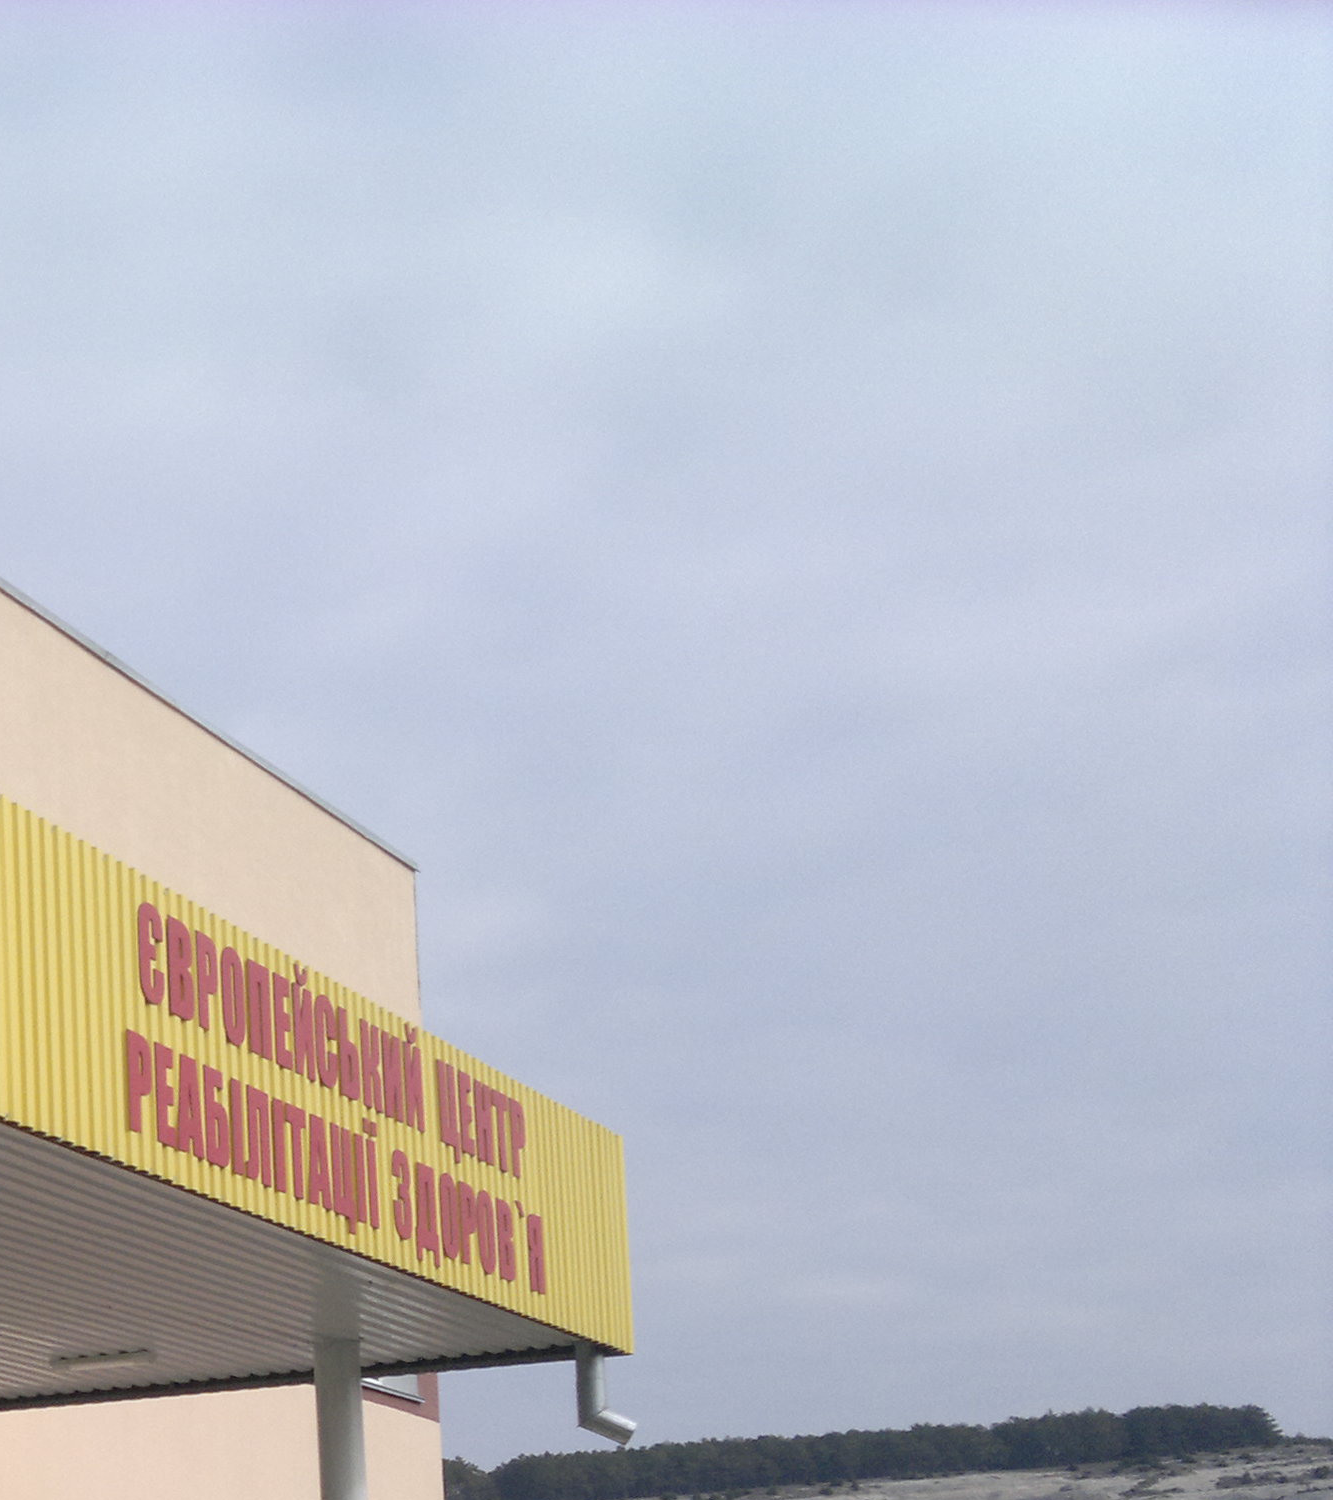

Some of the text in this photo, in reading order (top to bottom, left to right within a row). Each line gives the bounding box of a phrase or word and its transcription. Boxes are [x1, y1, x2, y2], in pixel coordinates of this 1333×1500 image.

[125, 1028, 381, 1236] РЕАБІЛІТАЦІЇ
[136, 901, 527, 1180] ЄВРОПЕЙСЬКИЙ ЦЕНТР
